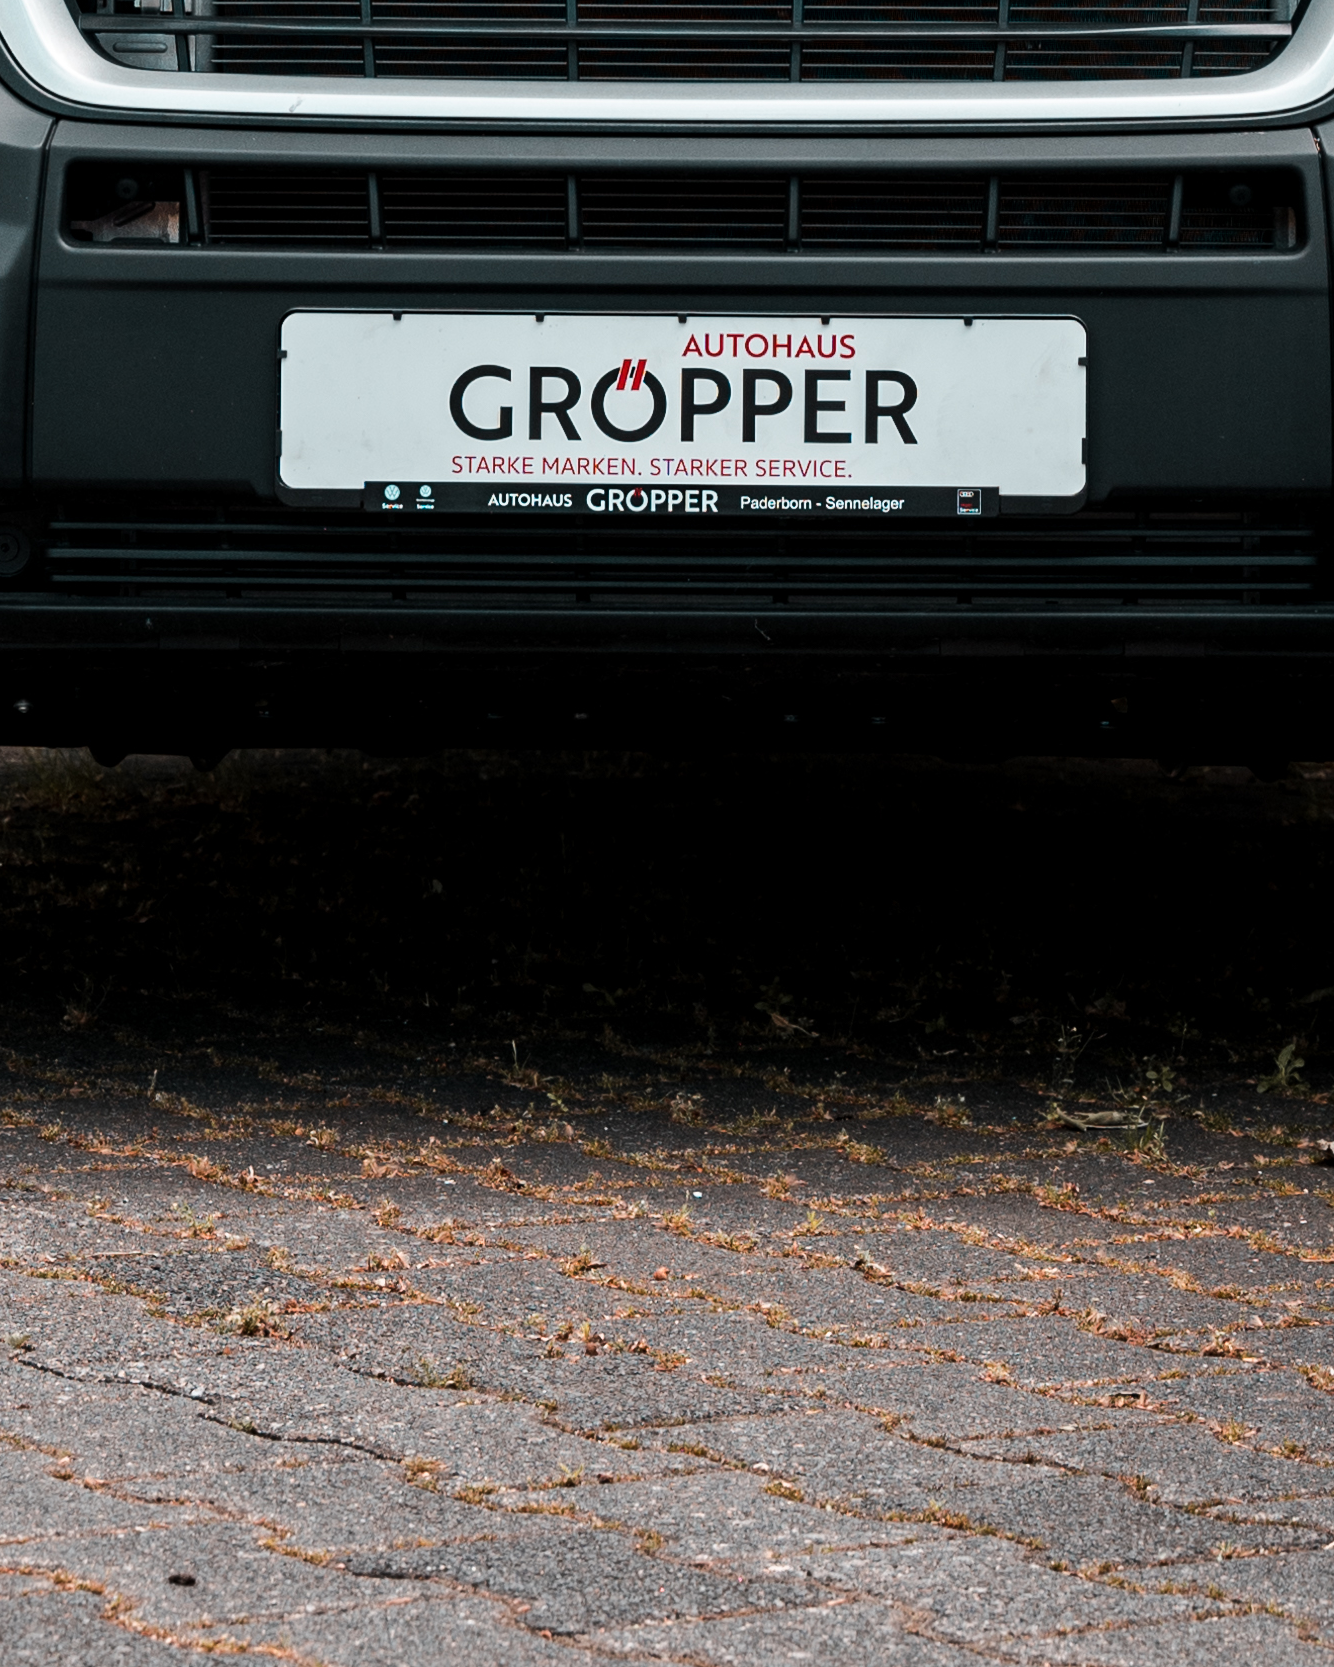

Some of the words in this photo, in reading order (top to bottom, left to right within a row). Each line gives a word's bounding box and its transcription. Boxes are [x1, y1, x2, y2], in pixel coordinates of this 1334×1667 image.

[681, 333, 856, 359] AUTOHAUS
[449, 358, 918, 445] GRÖPPER
[451, 455, 535, 475] STARKE
[542, 456, 642, 476] MARKEN.
[649, 457, 748, 477] STARKER
[755, 458, 853, 478] SERVICE.
[487, 492, 573, 508] AUTOHAUS
[585, 486, 719, 513] GRÖPPER
[740, 495, 813, 510] Paderborn
[825, 495, 905, 514] Sennelager
